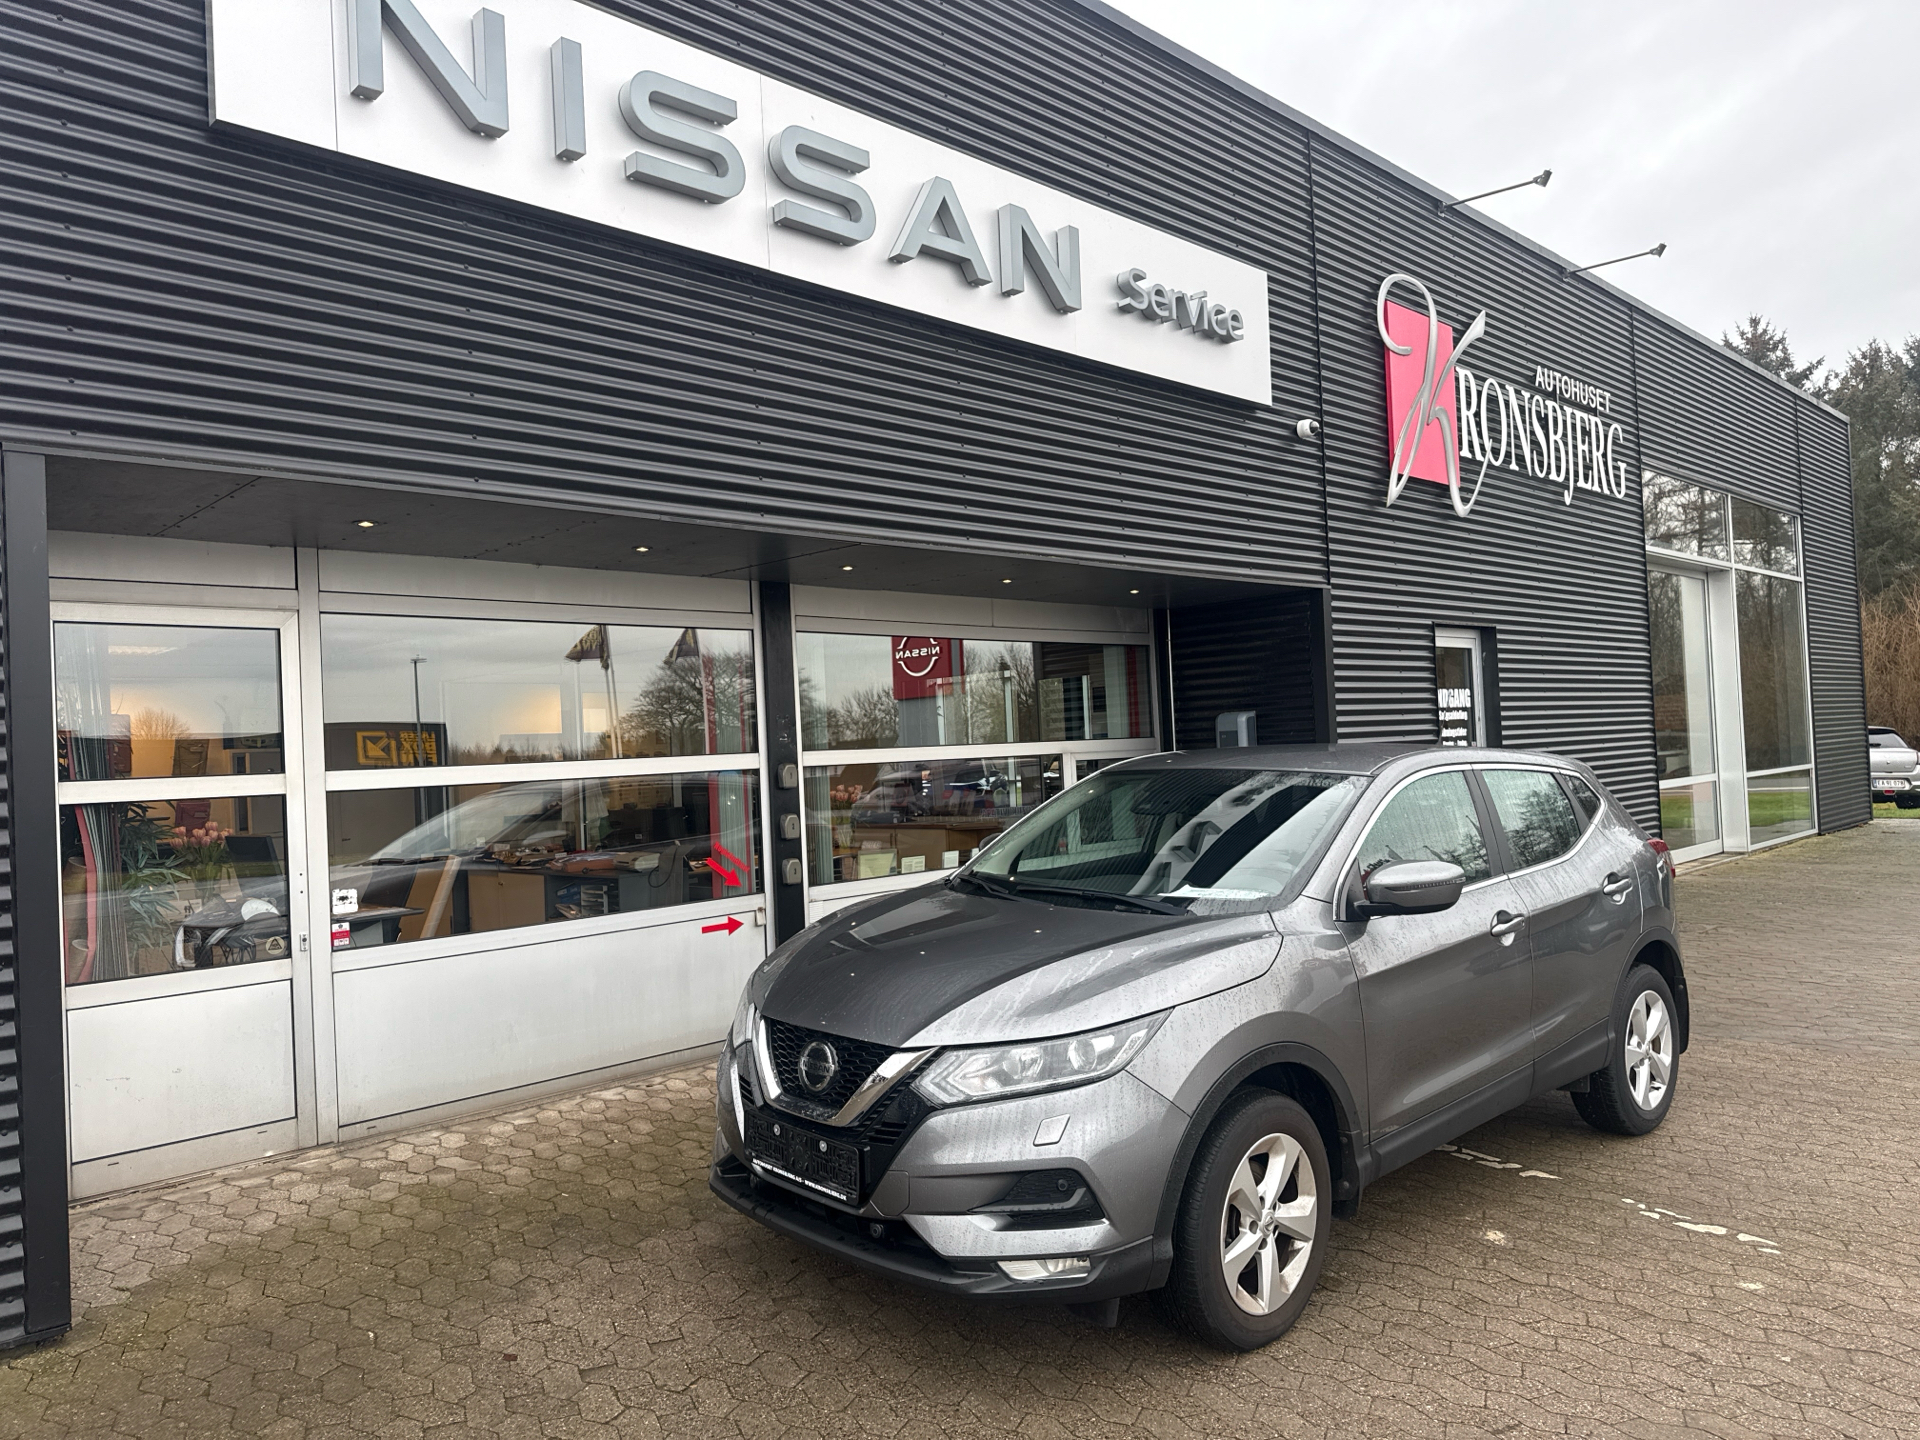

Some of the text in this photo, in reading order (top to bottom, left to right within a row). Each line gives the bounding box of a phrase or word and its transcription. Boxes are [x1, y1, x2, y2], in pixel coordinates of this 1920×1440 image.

[347, 0, 1244, 344] NISSAN Service
[1535, 366, 1611, 413] AUTOHUSET
